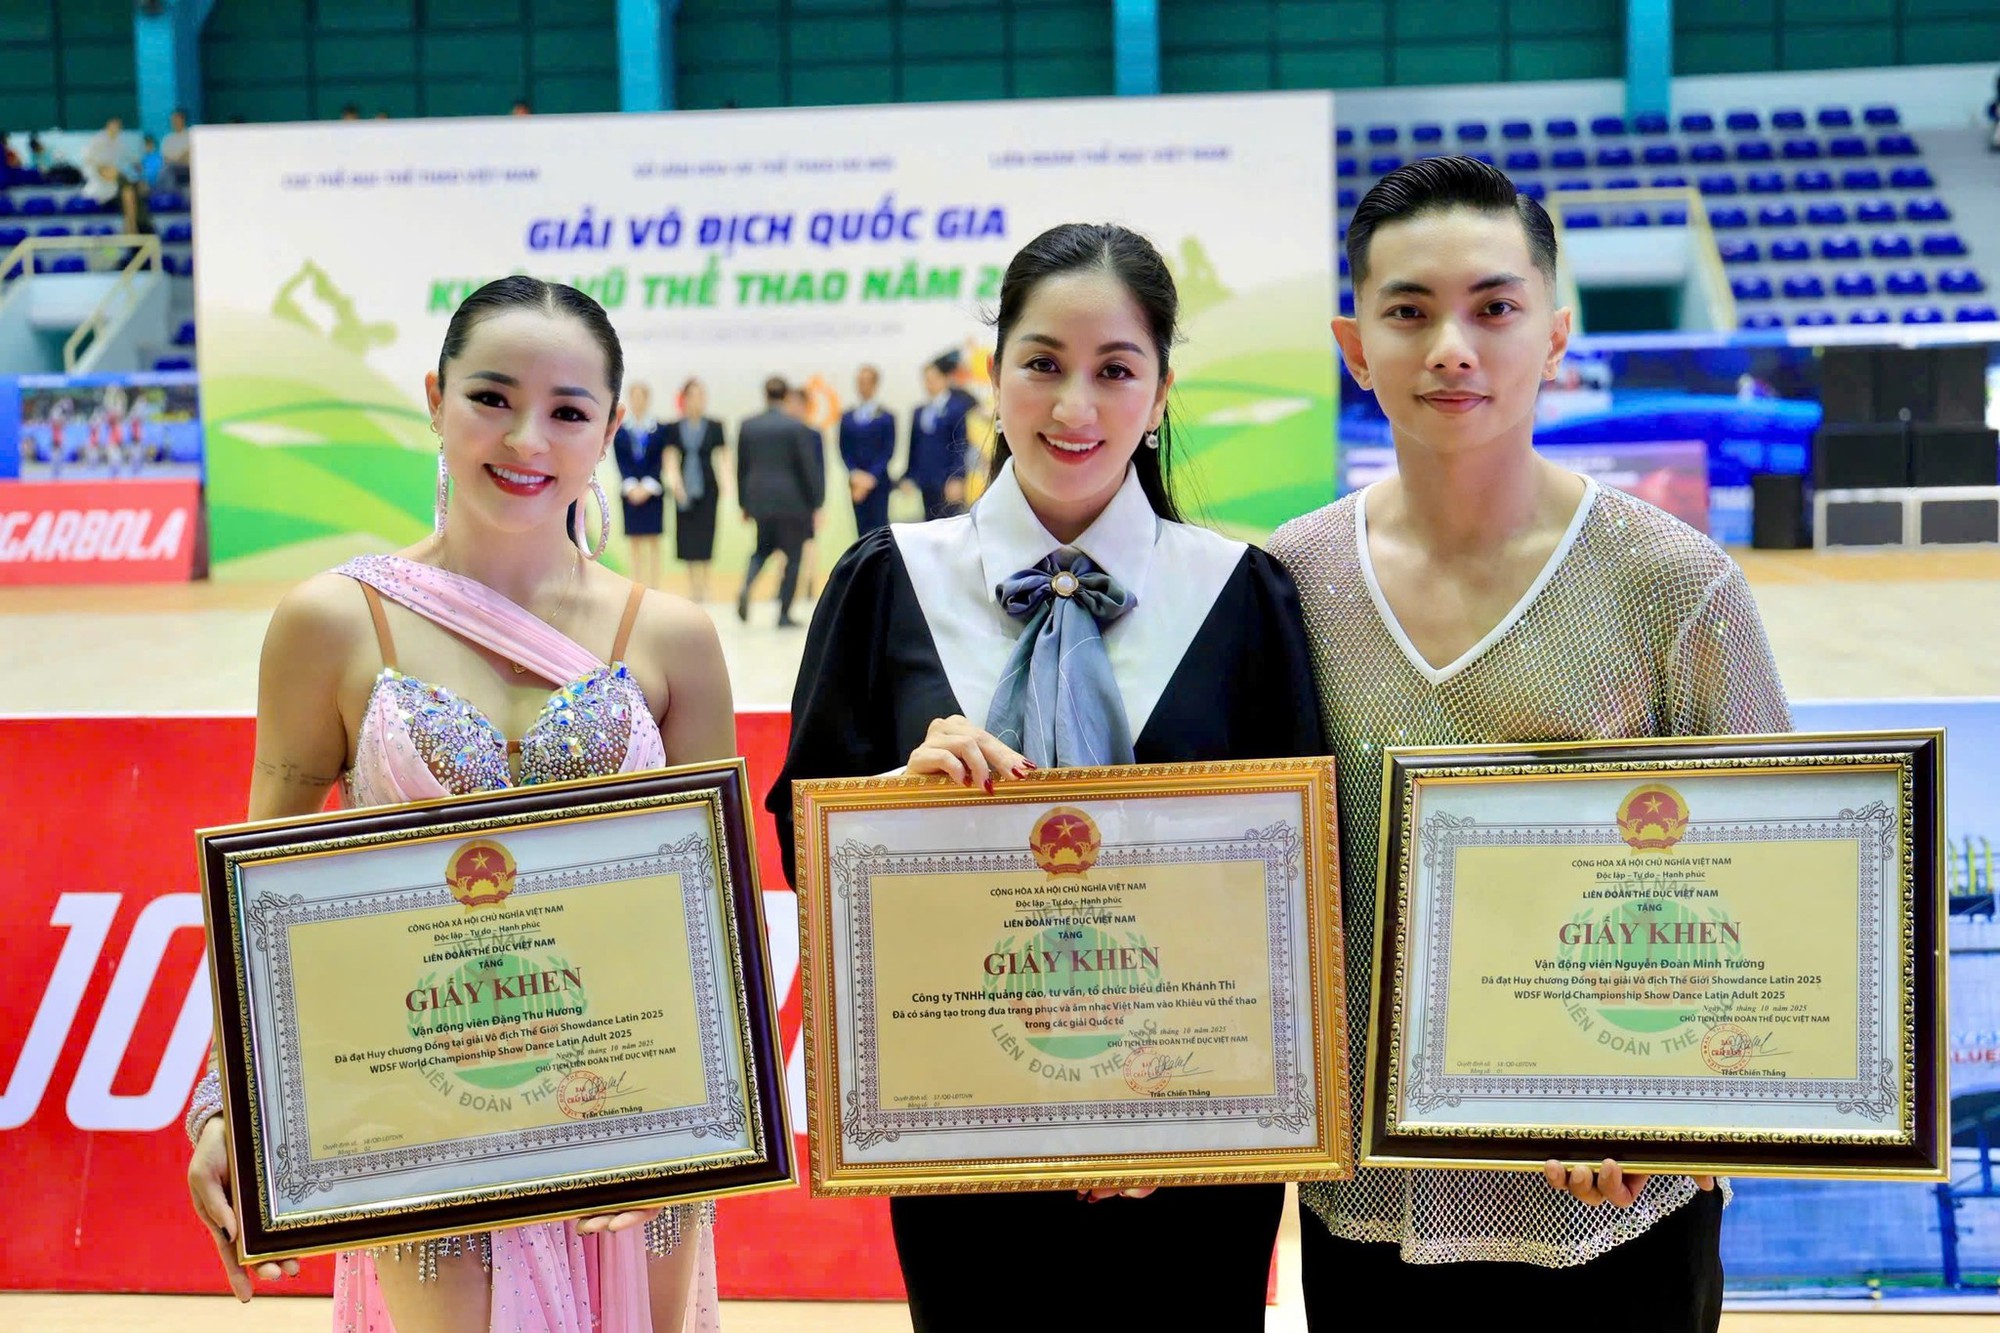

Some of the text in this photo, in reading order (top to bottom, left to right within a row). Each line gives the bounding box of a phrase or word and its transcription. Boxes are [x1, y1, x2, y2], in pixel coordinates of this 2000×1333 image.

[527, 195, 1006, 256] GIẢI VÔ ĐỊCH QUỐC GIA
[736, 271, 847, 304] THAO
[862, 259, 962, 299] NĂM
[0, 509, 187, 562] GARBOLA
[1571, 857, 1732, 869] CỘNG HÒA XÃ HỘI CHỦ NGHĨA VIỆT NAM
[989, 882, 1147, 898] CỘNG HÒA XÃ HỘI CHỦ NGHĨA VIỆT NAM
[1582, 888, 1719, 900] LIÊN ĐOÀN THỂ DỤC VIỆT NAM
[1637, 903, 1663, 912] TẶNG
[1003, 914, 1136, 929] LIÊN ĐOÀN THỂ DỤC VIỆT NAM
[1559, 916, 1742, 945] GIẤY KHEN
[1058, 931, 1083, 941] TẶNG
[423, 937, 556, 964] LIÊN ĐOÀN THỂ DỤC VIỆT NAM
[983, 945, 1160, 976] GIẤY KHEN
[478, 958, 504, 971] TẶNG
[1534, 958, 1765, 972] Vận động viên Nguyễn Đoàn Minh Trường
[405, 967, 582, 1012] GIẤY KHEN
[911, 979, 1236, 1005] Công ty TNHH quảng cáo, tư vấn, tổ chức biểu diễn Khánh Thi
[1481, 975, 1822, 987] Đã đạt Huy chương Đồng tại giải Vô địch Thế Giới Showdance Latin 2025
[892, 995, 1257, 1020] Đã có sáng tạo trong đưa trang phục và âm nhạc Việt Nam vào Khiêu vũ thể thao
[1513, 990, 1786, 1002] WDSF World Championship Show Dance Latin Adult 2025
[412, 1006, 583, 1039] Vận động viên Đặng Thu Hương
[1024, 1015, 1124, 1031] trong các giải Quốc tế
[334, 1009, 664, 1064] Đã đạt Huy chương Đồng tại giải Vô địch Thế Giới Showdance Latin 2025
[369, 1028, 632, 1074] WDSF World Championship Show Dance Latin Adult 2025
